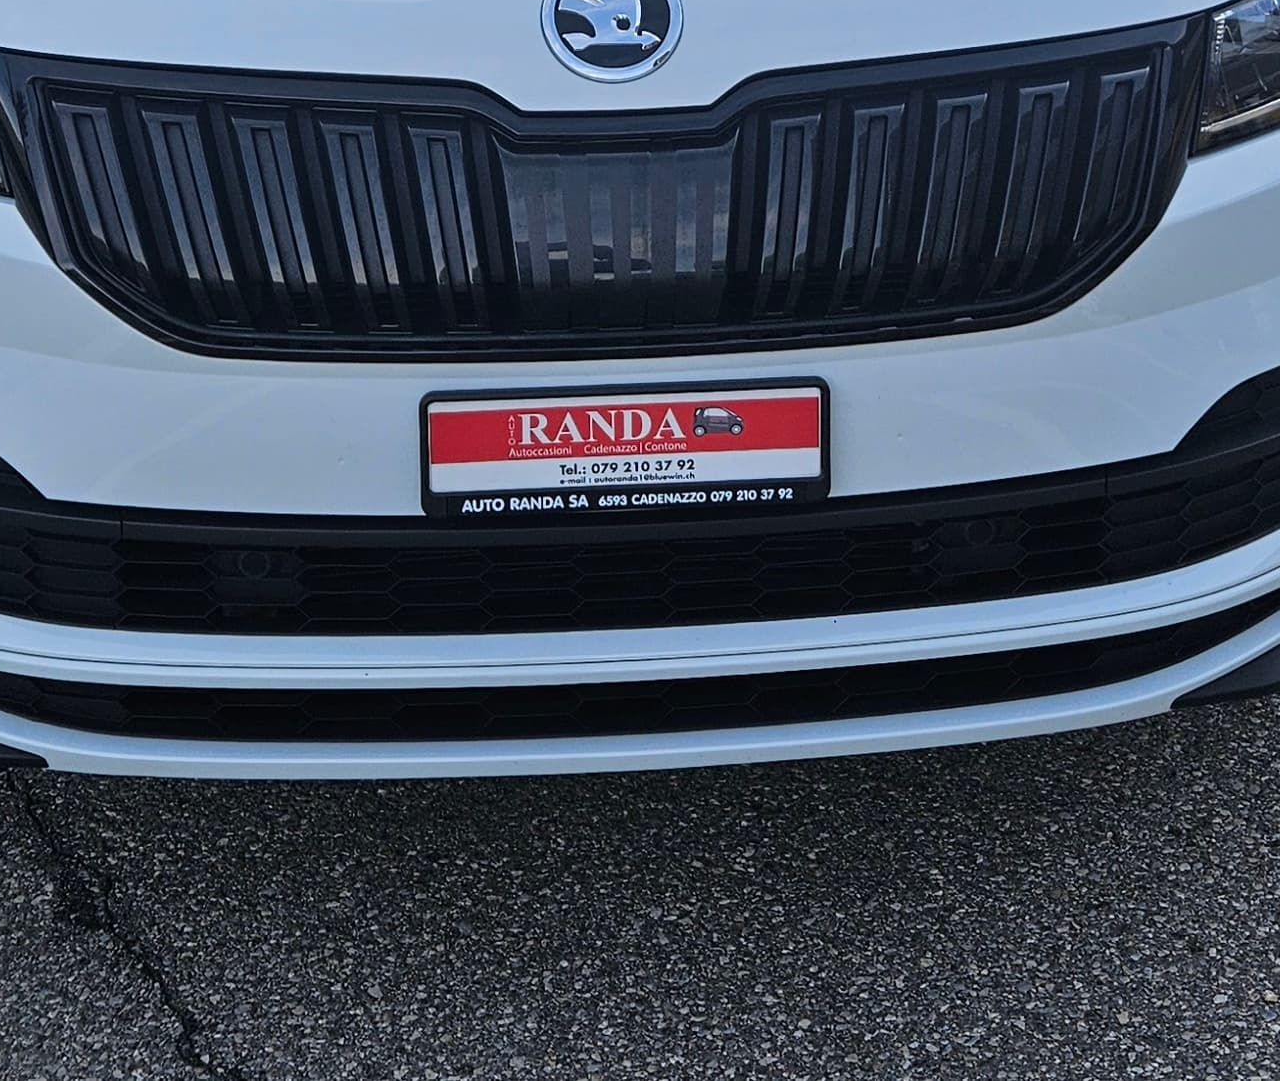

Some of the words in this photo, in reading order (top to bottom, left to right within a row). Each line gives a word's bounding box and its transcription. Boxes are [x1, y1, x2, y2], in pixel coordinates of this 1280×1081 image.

[507, 414, 516, 447] AUTO
[517, 407, 687, 446] RANDA
[508, 446, 573, 458] Autoccasioni
[583, 442, 638, 455] Cadenazzo
[644, 441, 688, 452] Contone
[559, 464, 587, 477] Tel.:
[591, 462, 619, 475] 079
[623, 460, 651, 473] 210
[655, 460, 673, 472] 37
[677, 458, 696, 471] 92
[461, 498, 505, 513] AUTO
[509, 496, 565, 511] RANDA
[568, 494, 589, 508] SA
[598, 494, 628, 507] 6593
[631, 491, 707, 506] CADENAZZO
[710, 490, 733, 503] 079
[736, 489, 758, 502] 210
[760, 488, 776, 501] 37
[777, 487, 794, 500] 92
